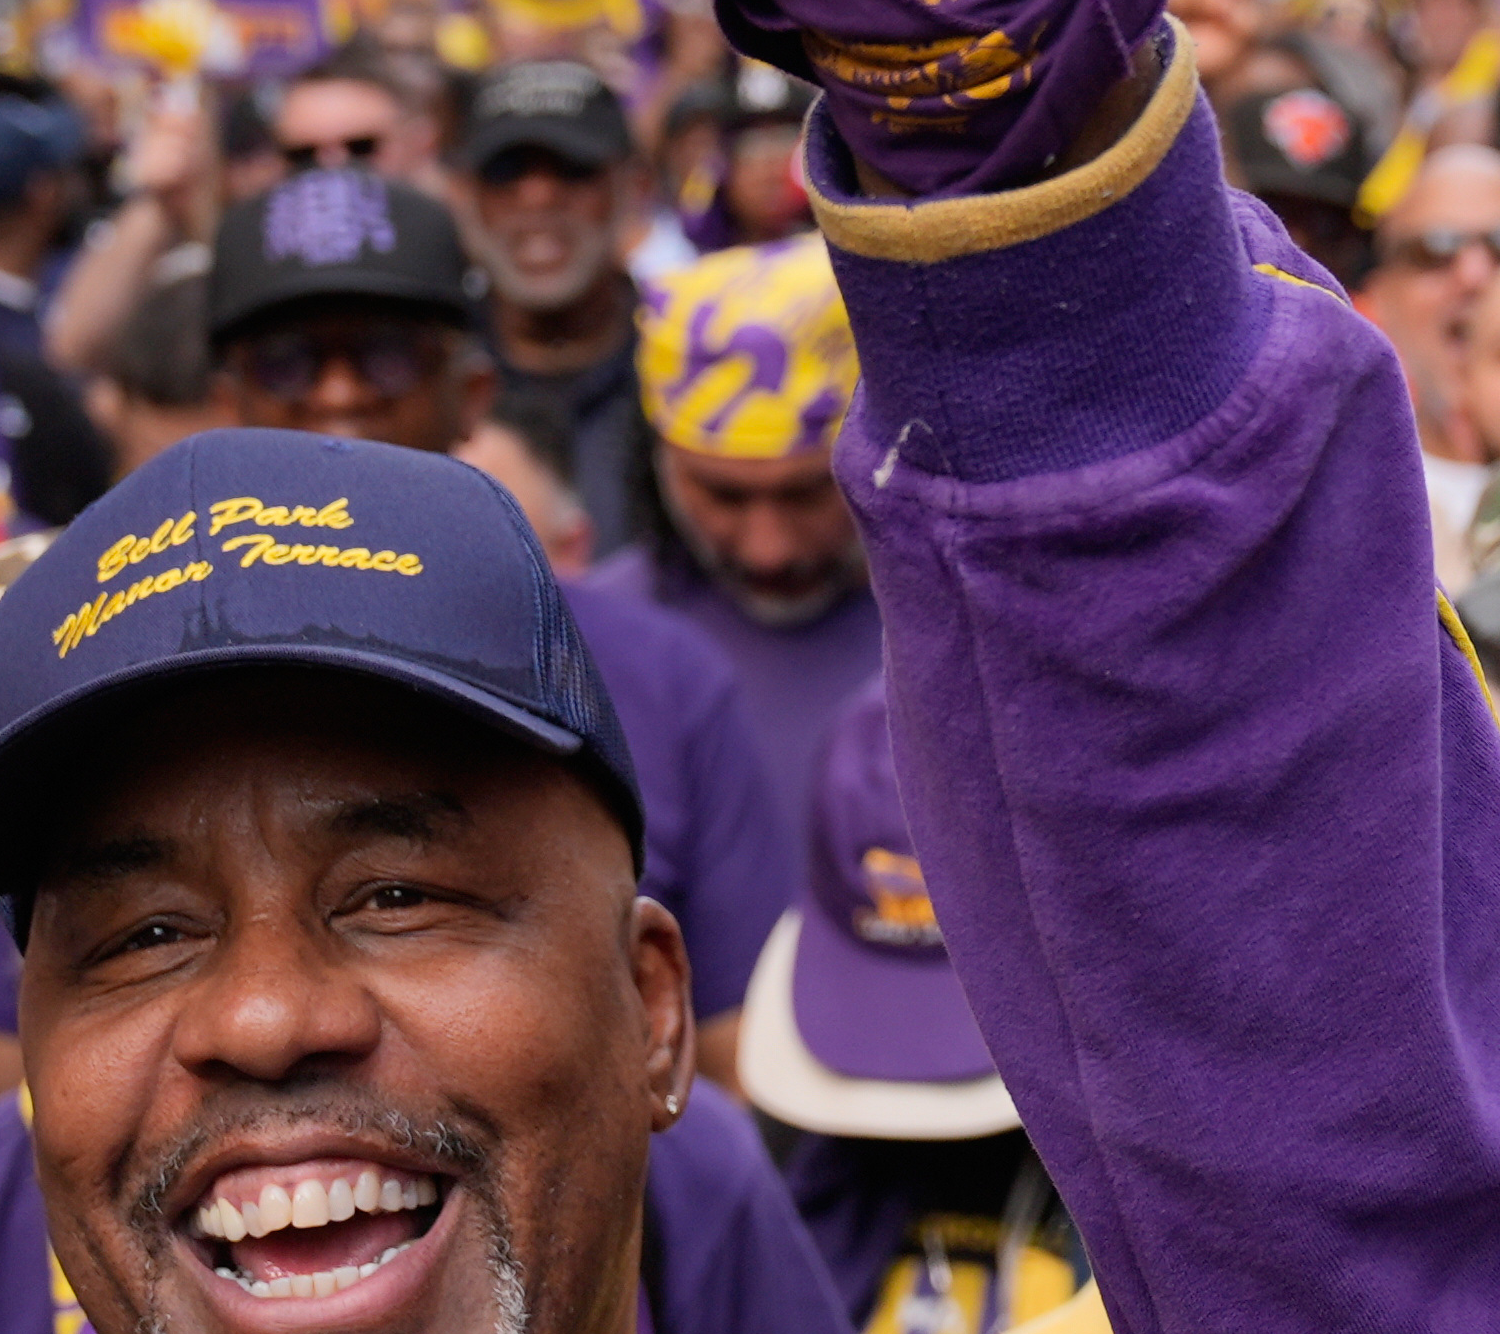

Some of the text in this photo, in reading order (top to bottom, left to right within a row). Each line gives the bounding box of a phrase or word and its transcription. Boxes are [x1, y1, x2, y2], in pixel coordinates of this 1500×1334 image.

[97, 495, 354, 583] Bell Park
[51, 532, 423, 658] Manor Terrace
